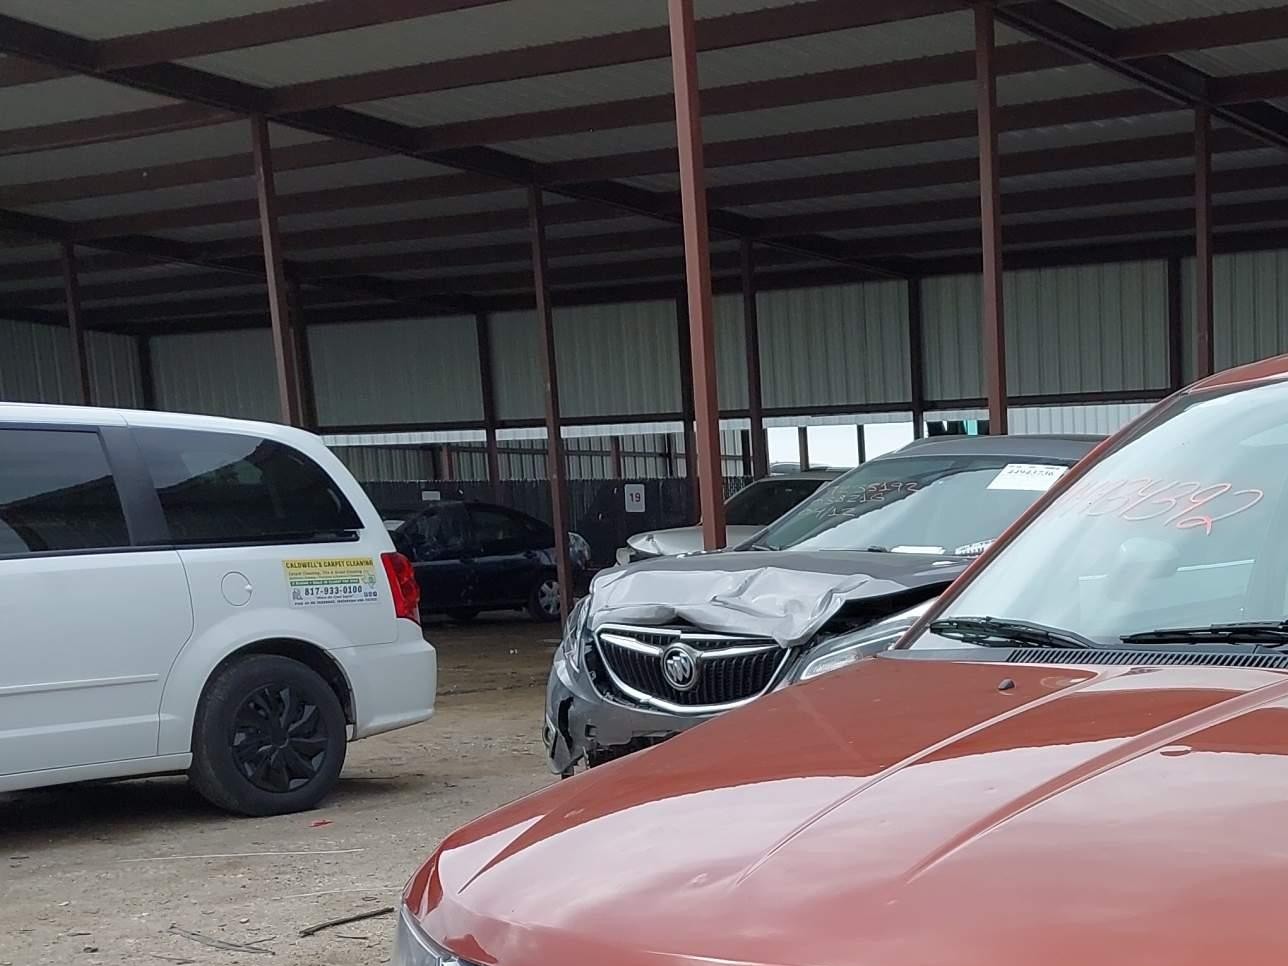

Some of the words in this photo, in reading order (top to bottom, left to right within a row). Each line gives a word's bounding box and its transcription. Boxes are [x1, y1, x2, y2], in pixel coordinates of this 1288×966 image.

[630, 493, 641, 502] 19
[324, 560, 345, 568] CARPET
[304, 585, 363, 596] 817-933-0100
